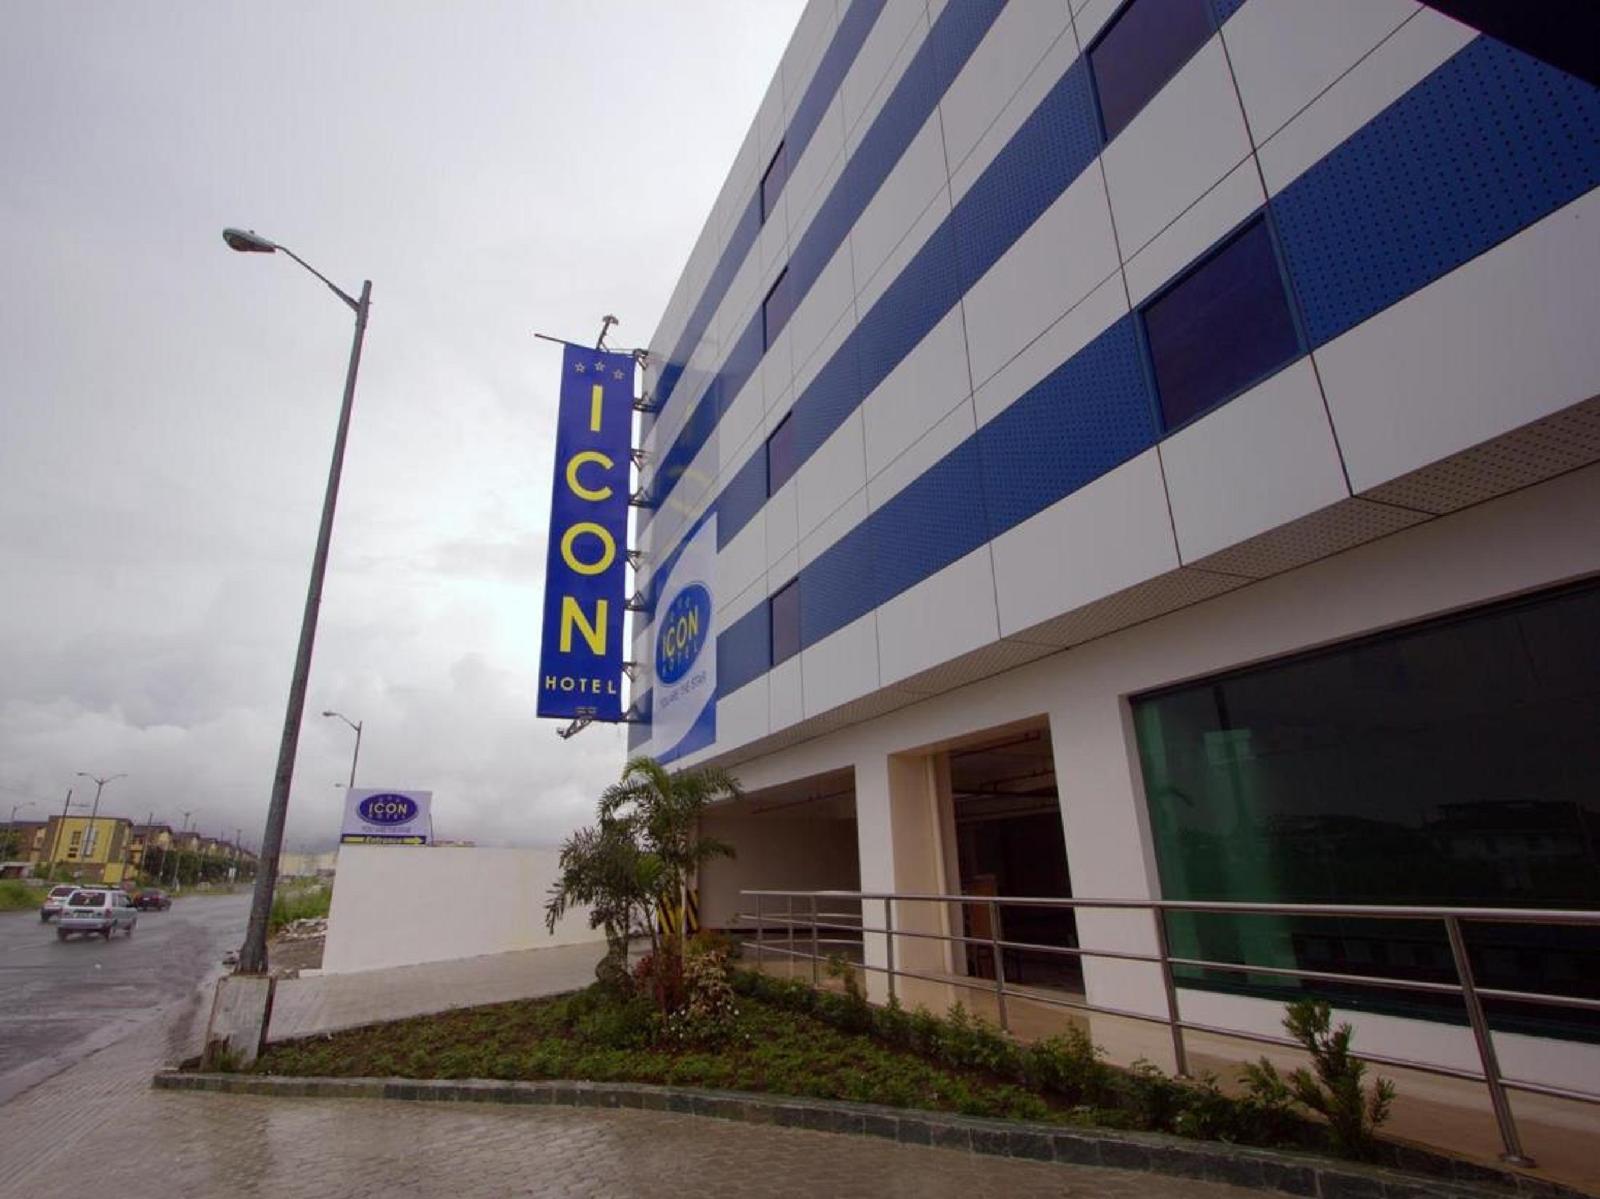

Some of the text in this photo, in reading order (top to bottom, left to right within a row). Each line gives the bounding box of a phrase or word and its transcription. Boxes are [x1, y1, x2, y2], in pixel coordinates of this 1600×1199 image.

[559, 385, 617, 656] ICON
[663, 606, 698, 660] ICON
[545, 675, 616, 695] HOTEL
[368, 803, 407, 815] ICON
